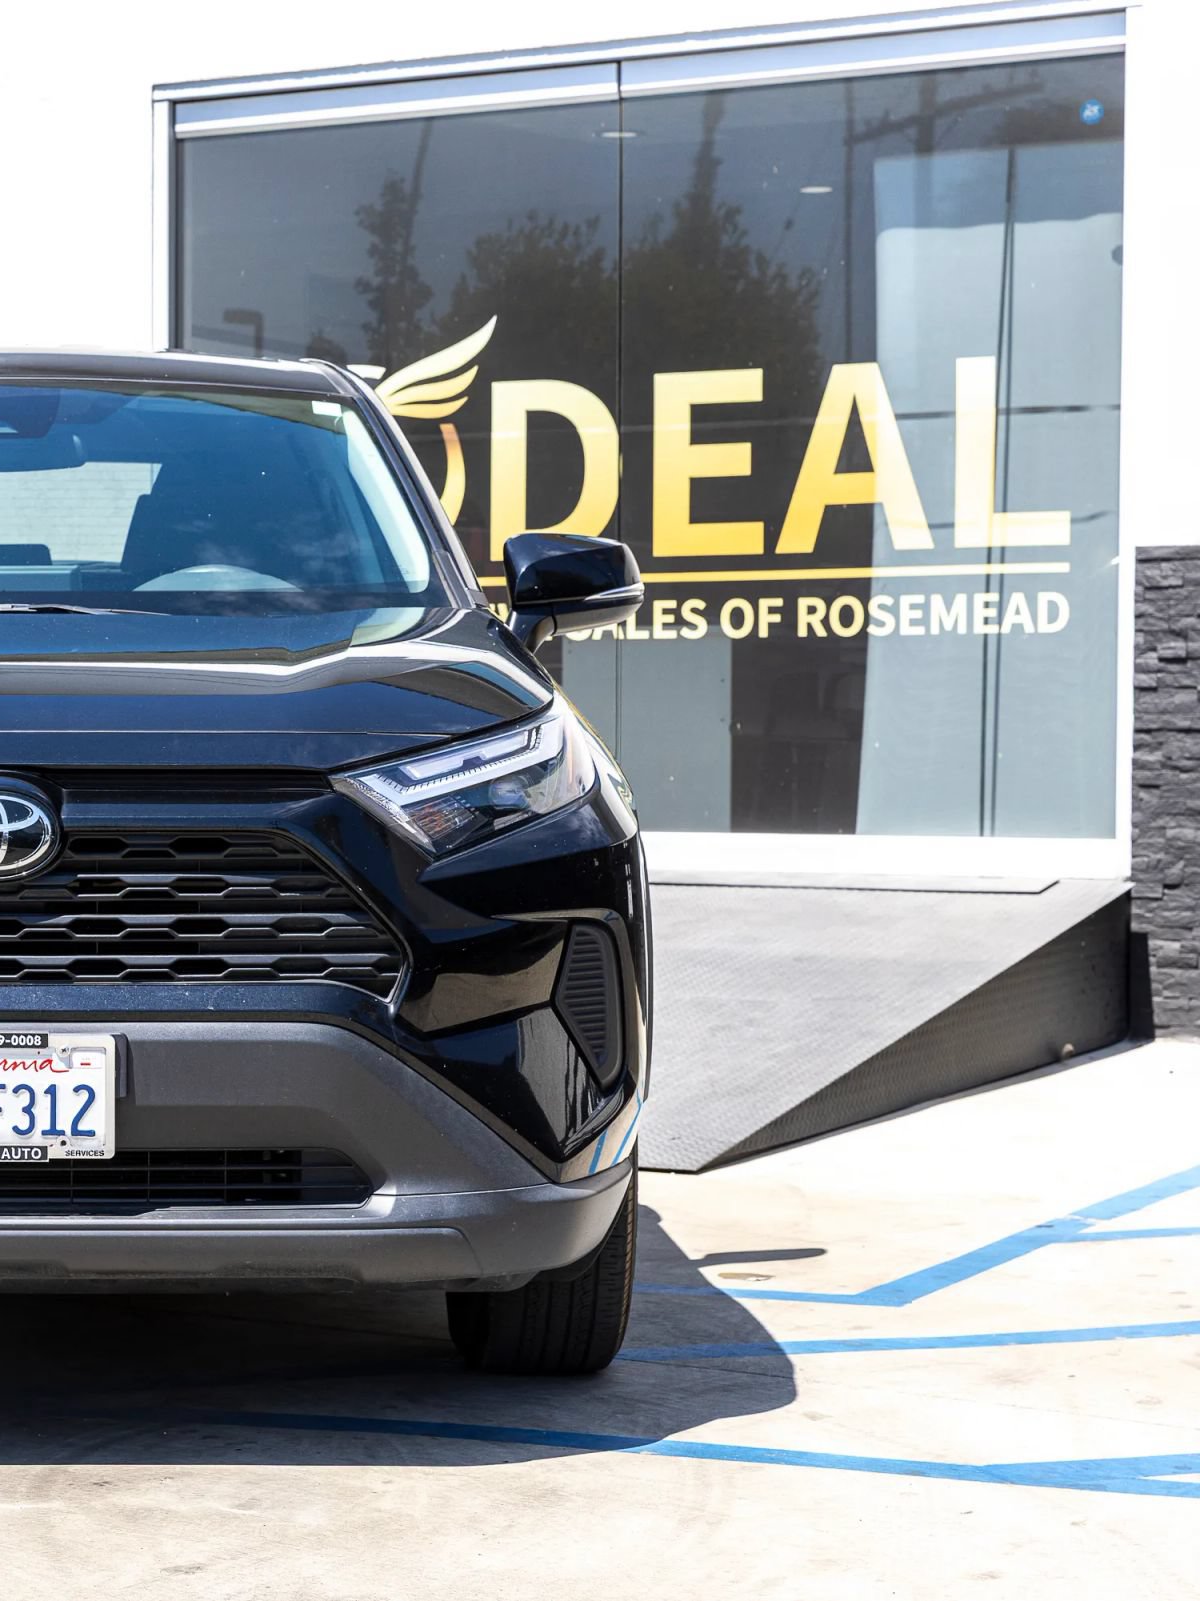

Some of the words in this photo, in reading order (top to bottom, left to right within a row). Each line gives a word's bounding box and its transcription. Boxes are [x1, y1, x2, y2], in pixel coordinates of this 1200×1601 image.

[719, 597, 784, 639] OF
[797, 591, 1071, 638] ROSEMEAD
[1, 1147, 42, 1159] AUTO
